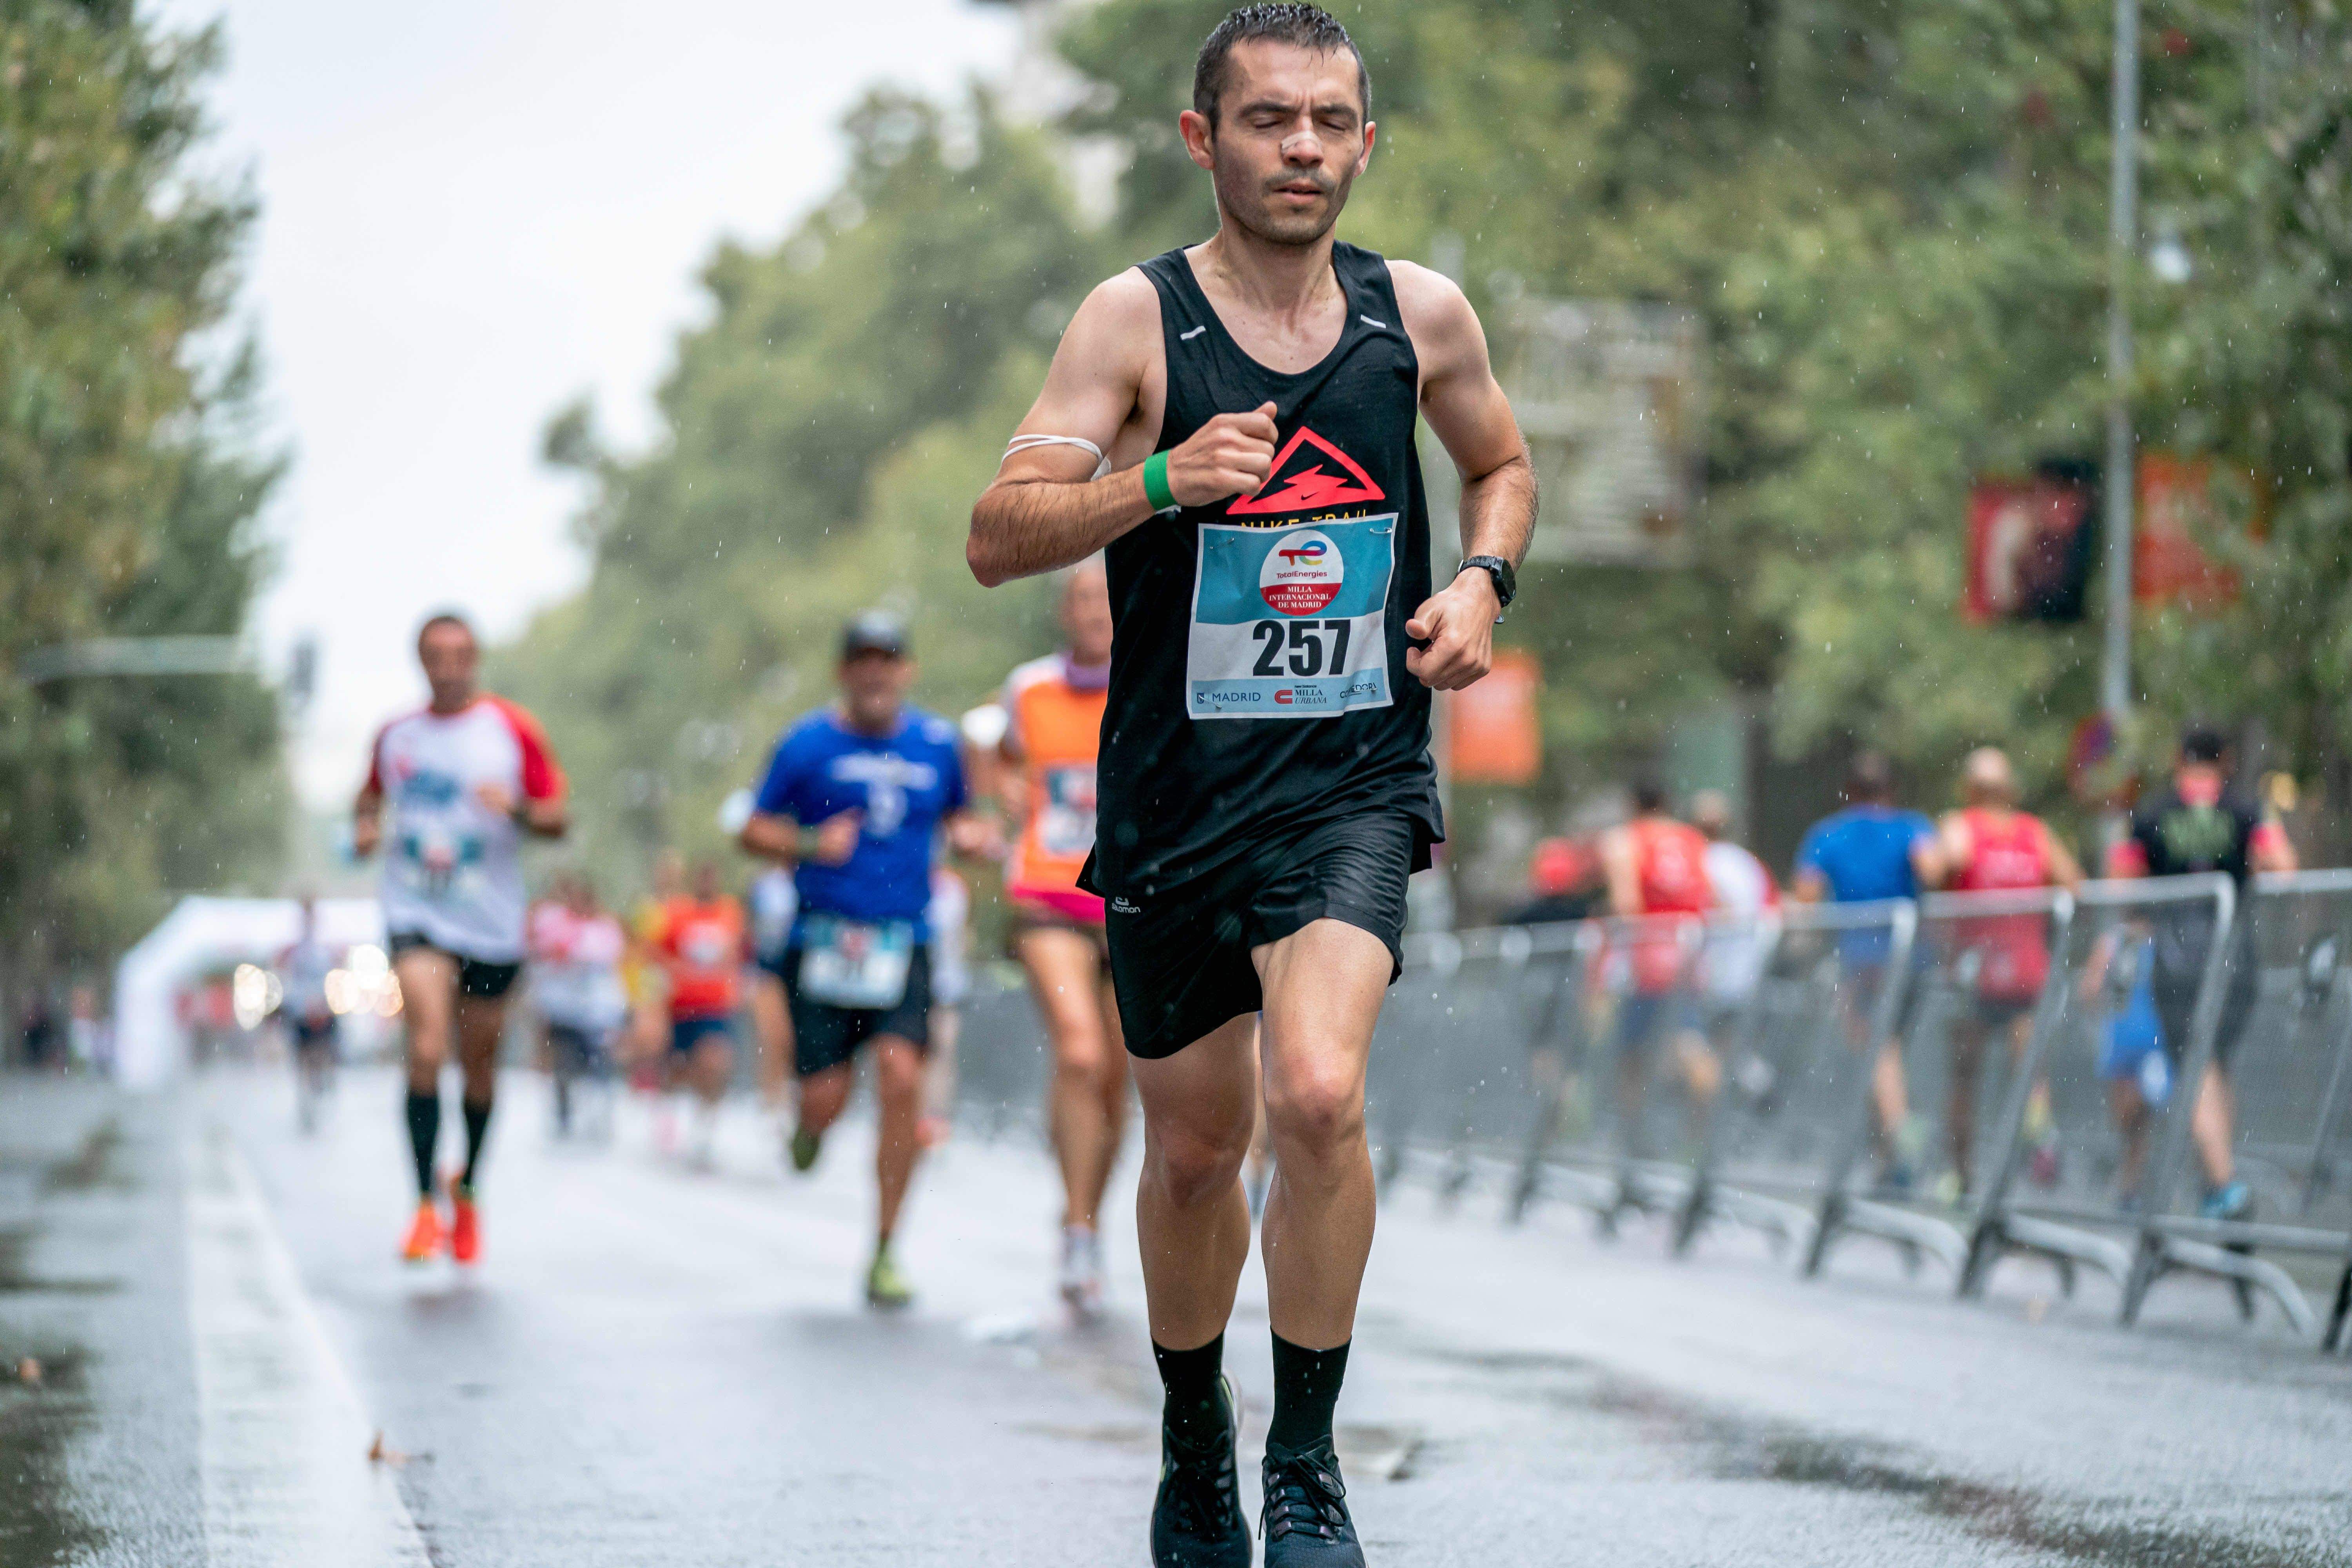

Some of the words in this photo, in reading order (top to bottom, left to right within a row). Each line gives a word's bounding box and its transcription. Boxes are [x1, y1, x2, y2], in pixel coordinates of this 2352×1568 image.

[1276, 570, 1327, 579] TotalEnergies
[1253, 619, 1351, 677] 257
[1212, 692, 1261, 702] MADRID
